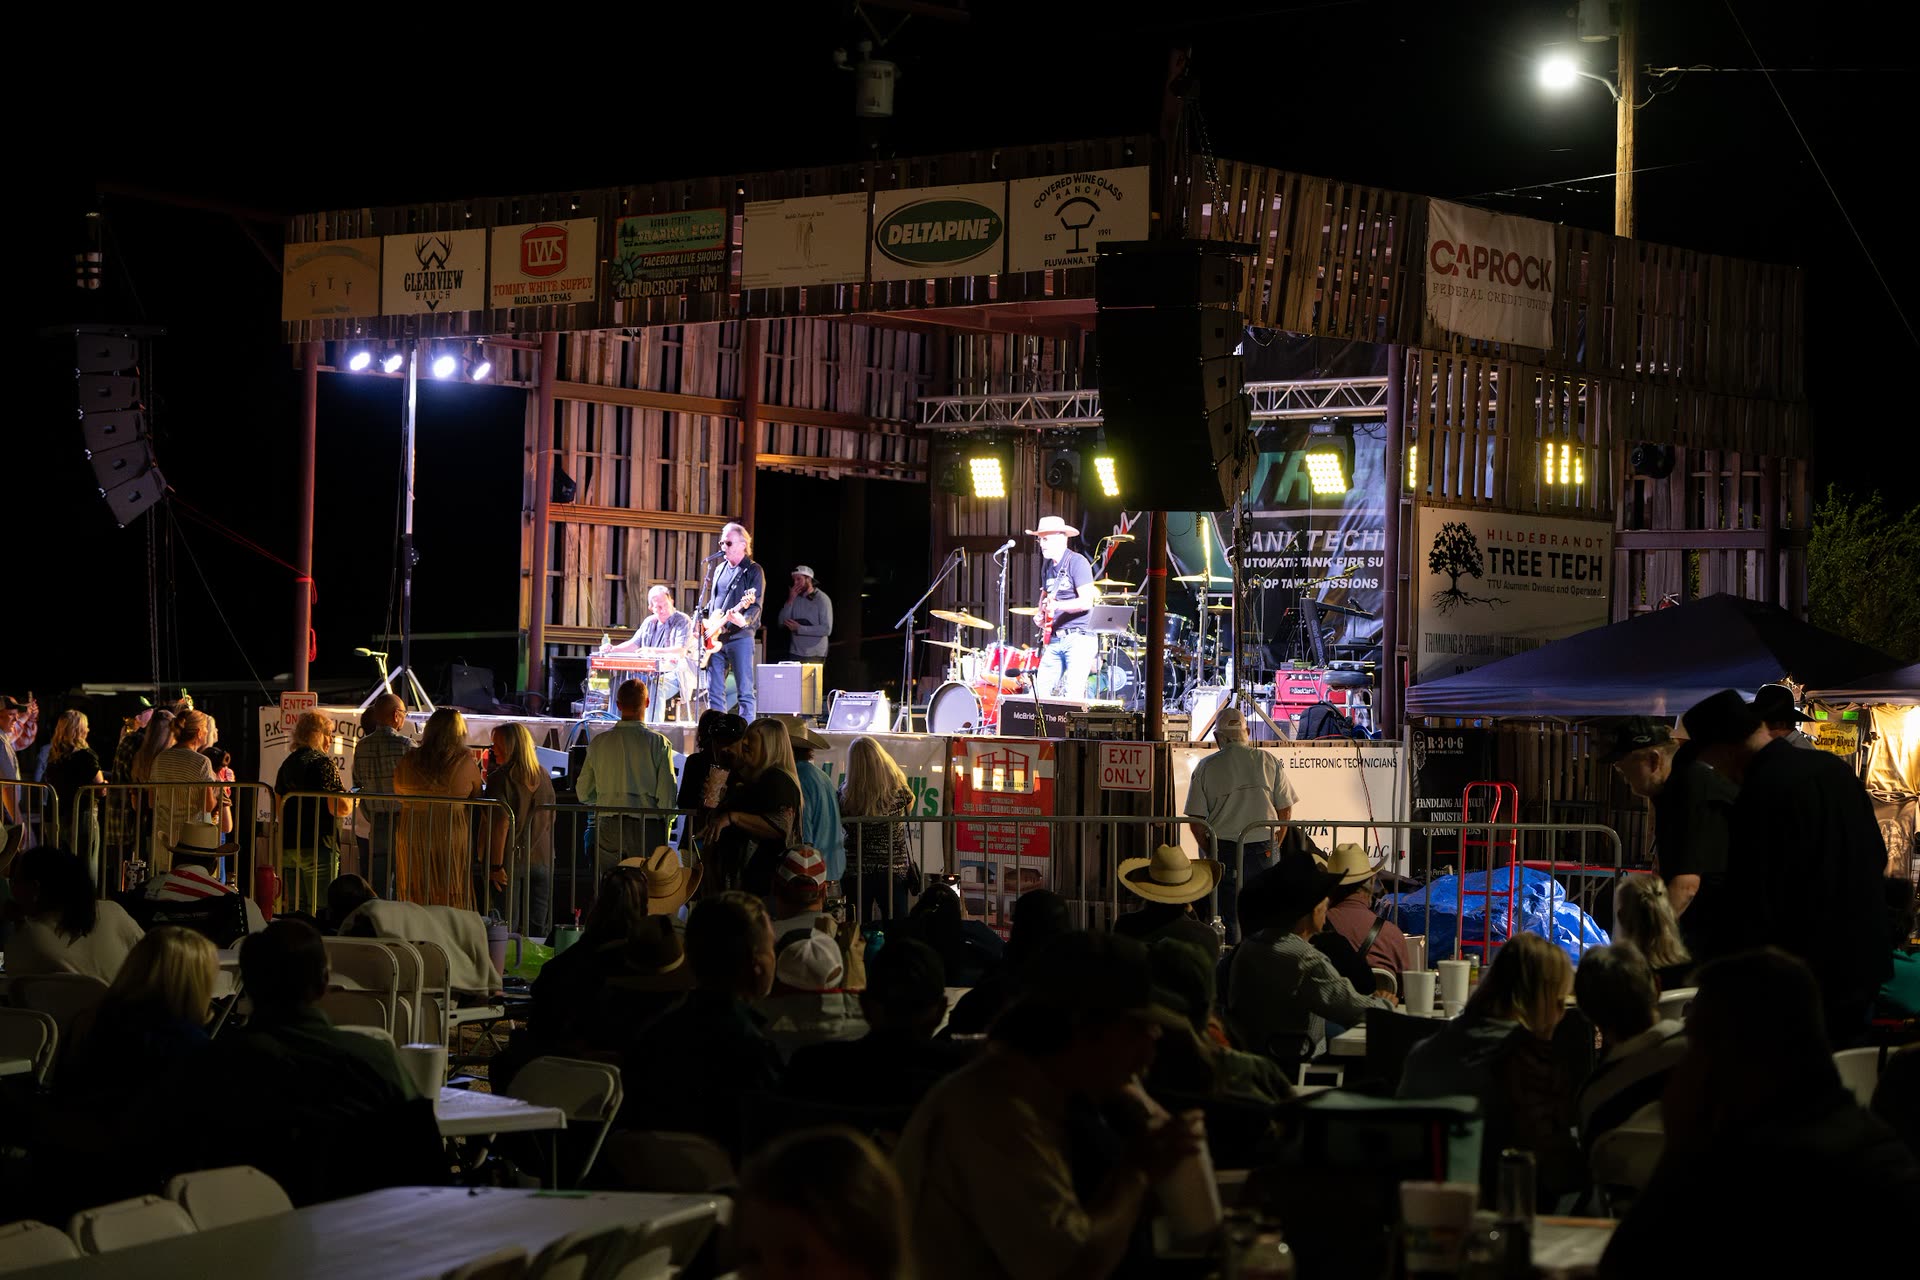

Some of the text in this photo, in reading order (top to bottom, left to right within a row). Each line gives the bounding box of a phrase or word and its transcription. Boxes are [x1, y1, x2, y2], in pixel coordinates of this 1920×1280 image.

[1033, 173, 1124, 209] COVERED WINE GLASS
[1055, 185, 1102, 201] RANCH
[887, 218, 990, 245] DELTAPINE
[1044, 233, 1057, 241] EST
[642, 254, 680, 267] FACEBOOK
[680, 252, 697, 264] LIVE
[1430, 239, 1553, 293] CAPROCK
[404, 270, 464, 292] CLEARVIEW
[493, 277, 593, 296] TOMMY WHITE SUPPLY
[619, 275, 718, 298] CLOUDCROFT NM
[415, 290, 451, 300] RANCH
[550, 292, 572, 302] TEXAS
[1432, 282, 1484, 300] FEDERAL
[1487, 291, 1522, 307] CREDIT
[1244, 530, 1302, 552] ANK
[1487, 529, 1603, 549] HILDEBRANDT
[1243, 557, 1299, 568] UTOMATIC
[1300, 557, 1333, 567] TANK
[1487, 547, 1603, 582] TREE TECH
[1487, 579, 1502, 589] TTU
[1531, 582, 1555, 593] Owned
[1556, 584, 1569, 594] and
[1570, 585, 1603, 597] Operated
[285, 714, 297, 725] ON
[1013, 711, 1035, 720] McBrid
[1045, 714, 1057, 722] The
[1109, 748, 1142, 764] EXIT
[1290, 758, 1343, 768] ELECTRONIC
[1344, 757, 1398, 768] TECHNICIANS
[1104, 767, 1146, 785] ONLY
[1416, 798, 1454, 808] HANDLING
[1431, 812, 1472, 822] INDUSTRL
[1422, 827, 1457, 836] CEANING
